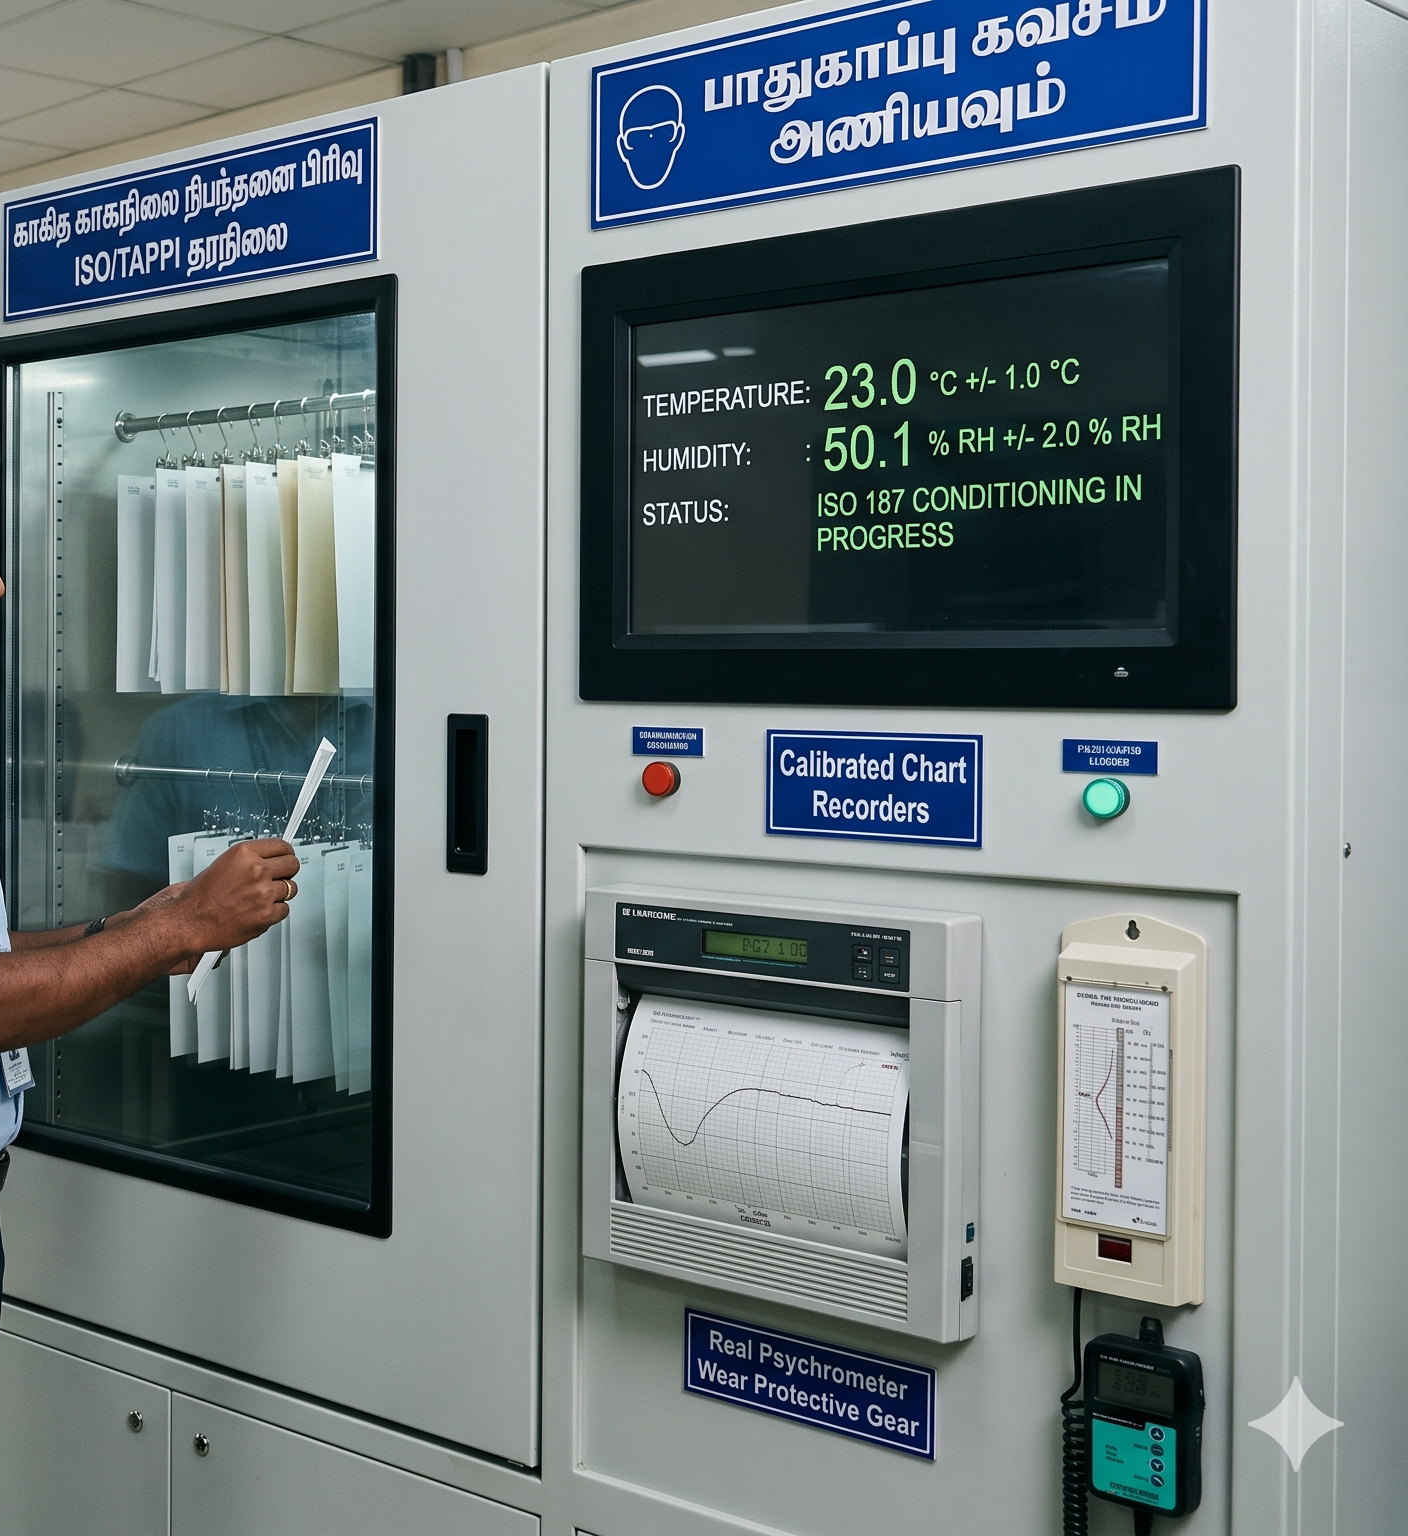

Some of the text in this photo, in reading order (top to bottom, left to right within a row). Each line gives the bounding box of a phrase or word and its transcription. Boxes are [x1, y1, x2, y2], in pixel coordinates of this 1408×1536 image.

[704, 0, 1167, 112] பாதுகாப்பு கவசம
[769, 60, 1066, 164] அணியவும்
[13, 144, 363, 249] காகித காகநிலை நிபந்தனை பிரிவு
[75, 222, 288, 287] ISO/TAPPI தரநிலை
[642, 357, 1080, 418] TEMPERATURE: 23.0 °C +/- 1.0 °C
[643, 441, 751, 473] HUMIDITY:
[823, 420, 909, 472] 50.1
[928, 429, 950, 456] %
[958, 426, 994, 454] RH
[1002, 423, 1035, 451] +/-
[1042, 420, 1080, 449] 2.0
[1088, 417, 1113, 446] %
[1122, 413, 1161, 443] RH
[642, 473, 1142, 527] STATUS: ISO 187 CONDITIONING IN
[817, 521, 954, 552] PROGRESS
[780, 749, 967, 784] Calibrated Chart
[813, 789, 930, 824] Recorders
[710, 1329, 908, 1400] Real Psychrometer
[697, 1358, 920, 1437] Wear Protective Gear
